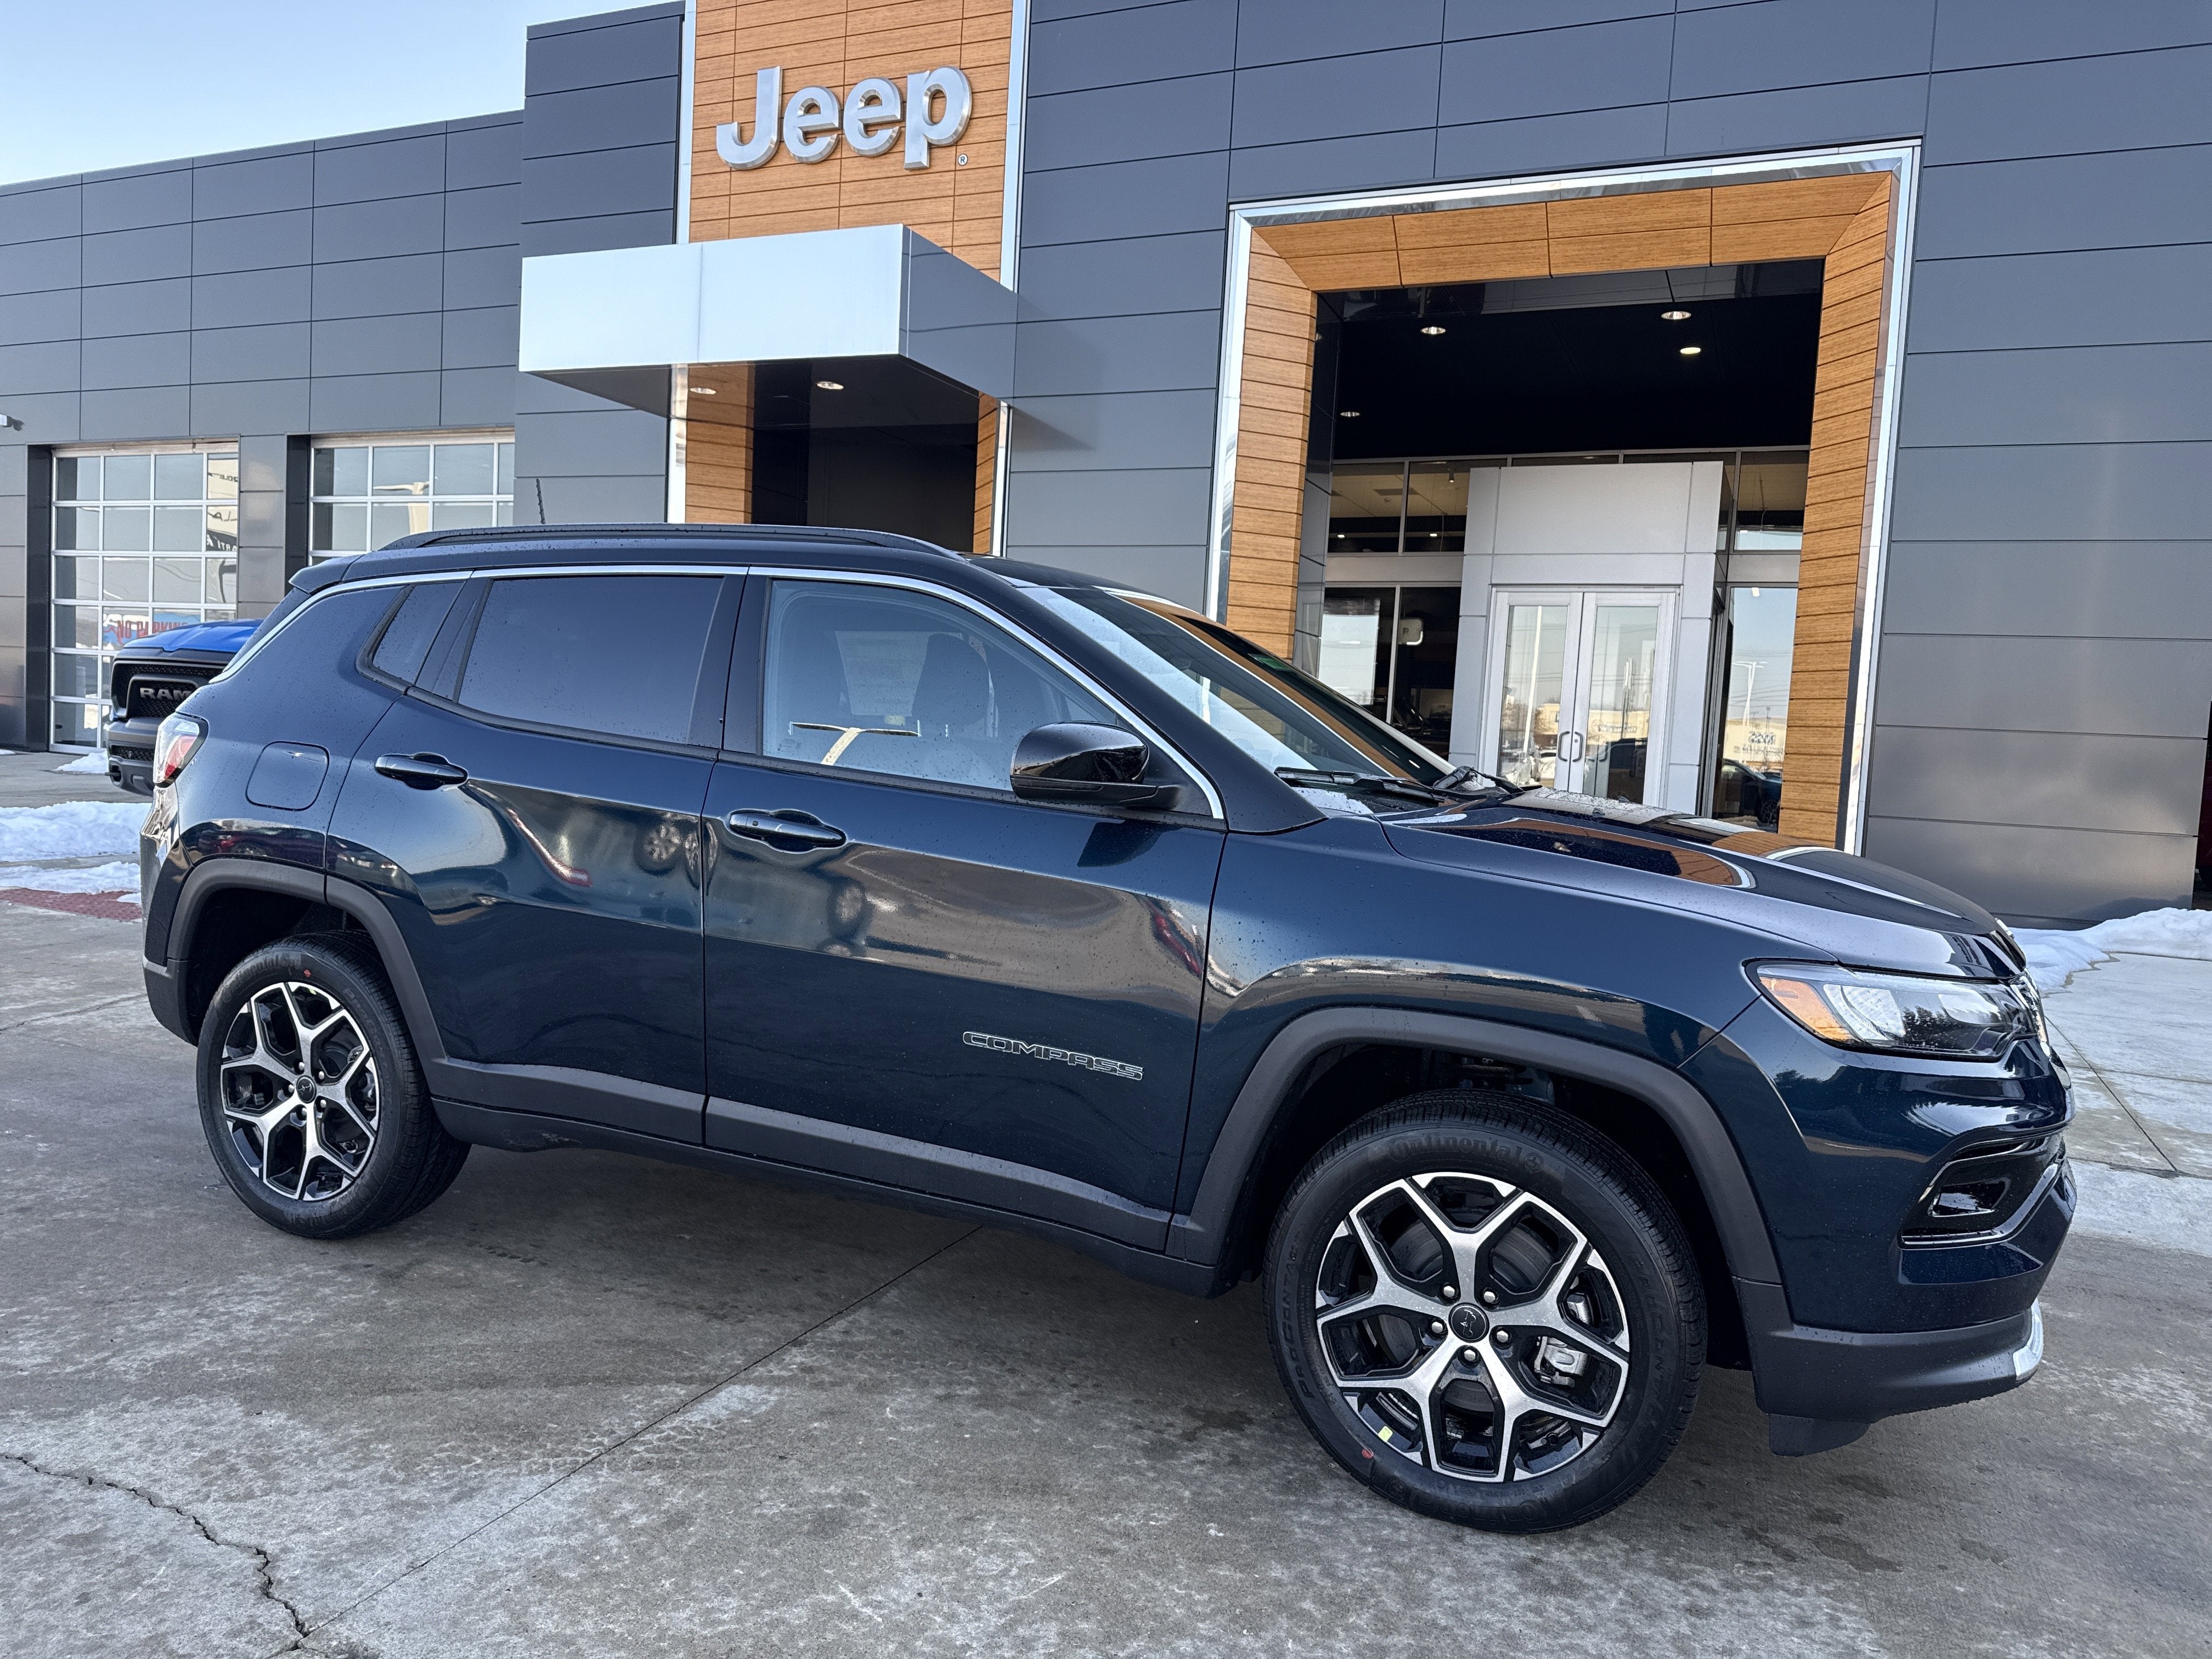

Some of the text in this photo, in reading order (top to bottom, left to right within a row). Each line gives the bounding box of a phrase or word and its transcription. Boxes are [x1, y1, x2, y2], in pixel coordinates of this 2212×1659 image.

[716, 65, 972, 171] Jeep
[117, 620, 188, 638] NO PARK
[139, 687, 192, 701] RAM
[962, 1031, 1144, 1081] COMPASS
[1388, 1132, 1523, 1162] Continental
